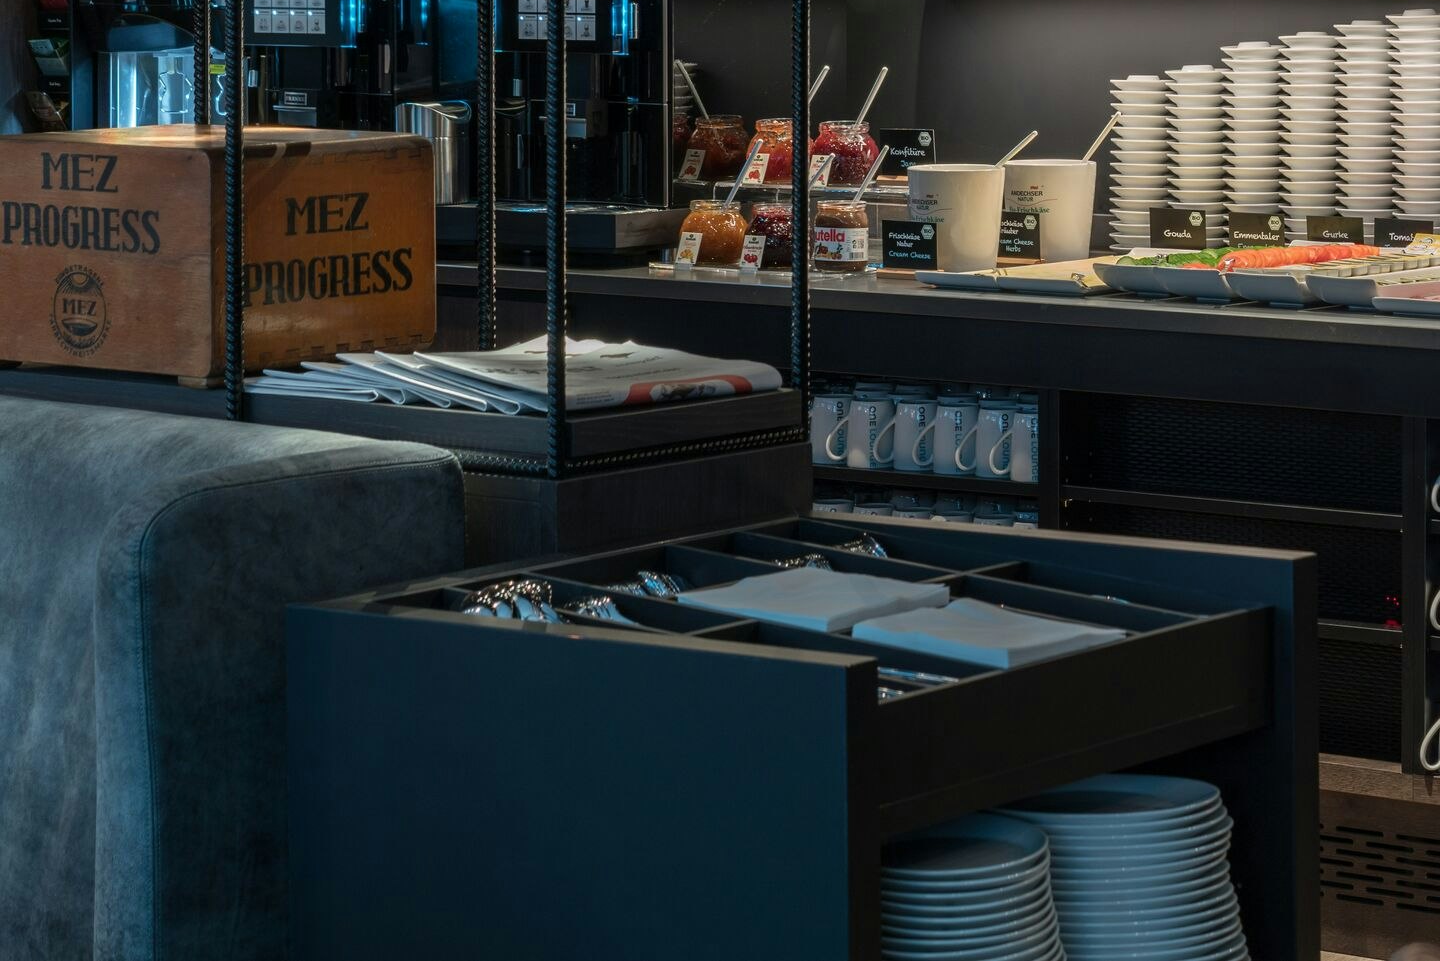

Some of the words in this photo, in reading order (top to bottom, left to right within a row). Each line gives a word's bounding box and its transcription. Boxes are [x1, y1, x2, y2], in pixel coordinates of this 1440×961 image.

[890, 146, 926, 157] Konfitüre
[40, 152, 119, 193] MEZ
[284, 192, 370, 237] MEZ
[2, 200, 161, 255] PROGRESS
[1163, 229, 1192, 239] Gouda
[1322, 230, 1349, 239] Gurke
[815, 229, 846, 243] utella
[1233, 231, 1280, 241] Emmentaler
[244, 247, 413, 308] PROGRESS
[62, 298, 97, 316] MEZ
